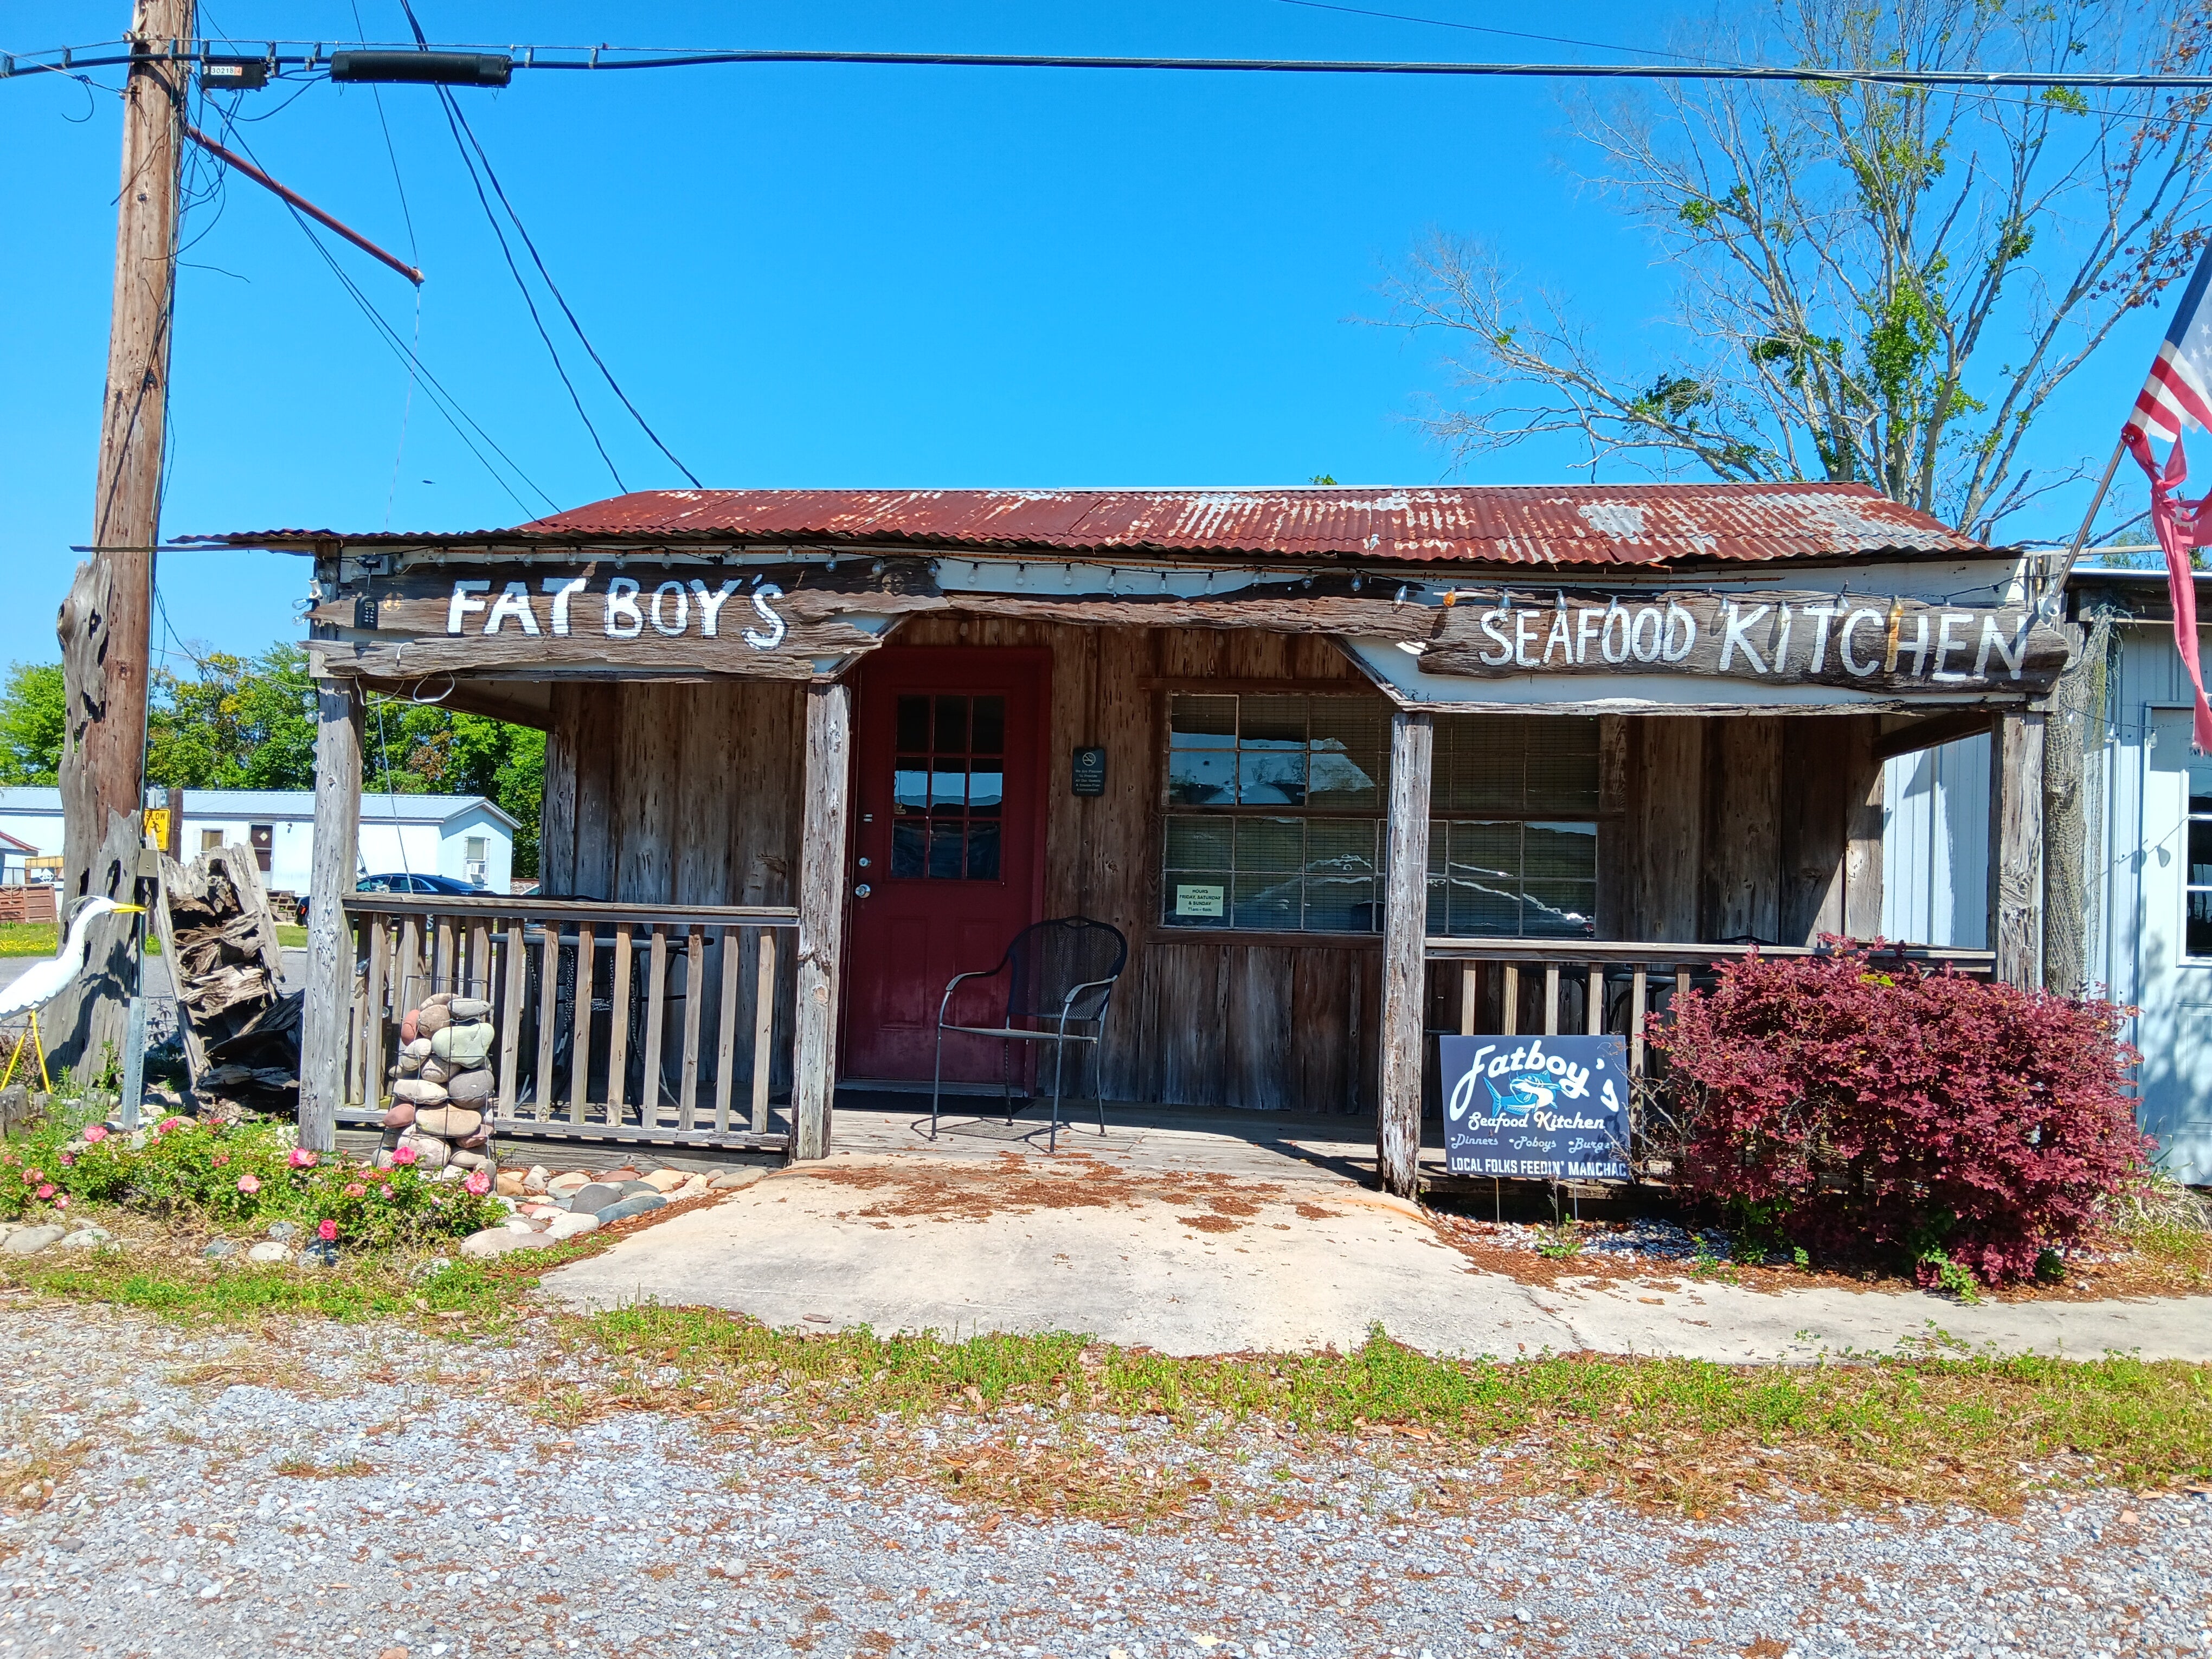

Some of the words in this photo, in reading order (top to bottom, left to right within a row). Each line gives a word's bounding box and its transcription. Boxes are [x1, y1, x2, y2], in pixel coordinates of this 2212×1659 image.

[447, 578, 588, 636] FAT
[603, 574, 788, 650] BOY'S
[1479, 606, 1696, 667] SEAFOOD
[1719, 603, 2028, 680] KITCHEN
[146, 811, 165, 820] SLOW
[1449, 1039, 1619, 1121] Fatboy's
[1468, 1111, 1529, 1133] Seafood
[1533, 1111, 1606, 1131] Kitchen
[1451, 1133, 1499, 1149] Dinners
[1514, 1136, 1557, 1153] Poboys
[1451, 1157, 1483, 1172] LOCAL
[1485, 1159, 1517, 1173] FOLKS
[1520, 1160, 1565, 1175] FEEDIN'
[1567, 1161, 1626, 1176] MANCHAC
